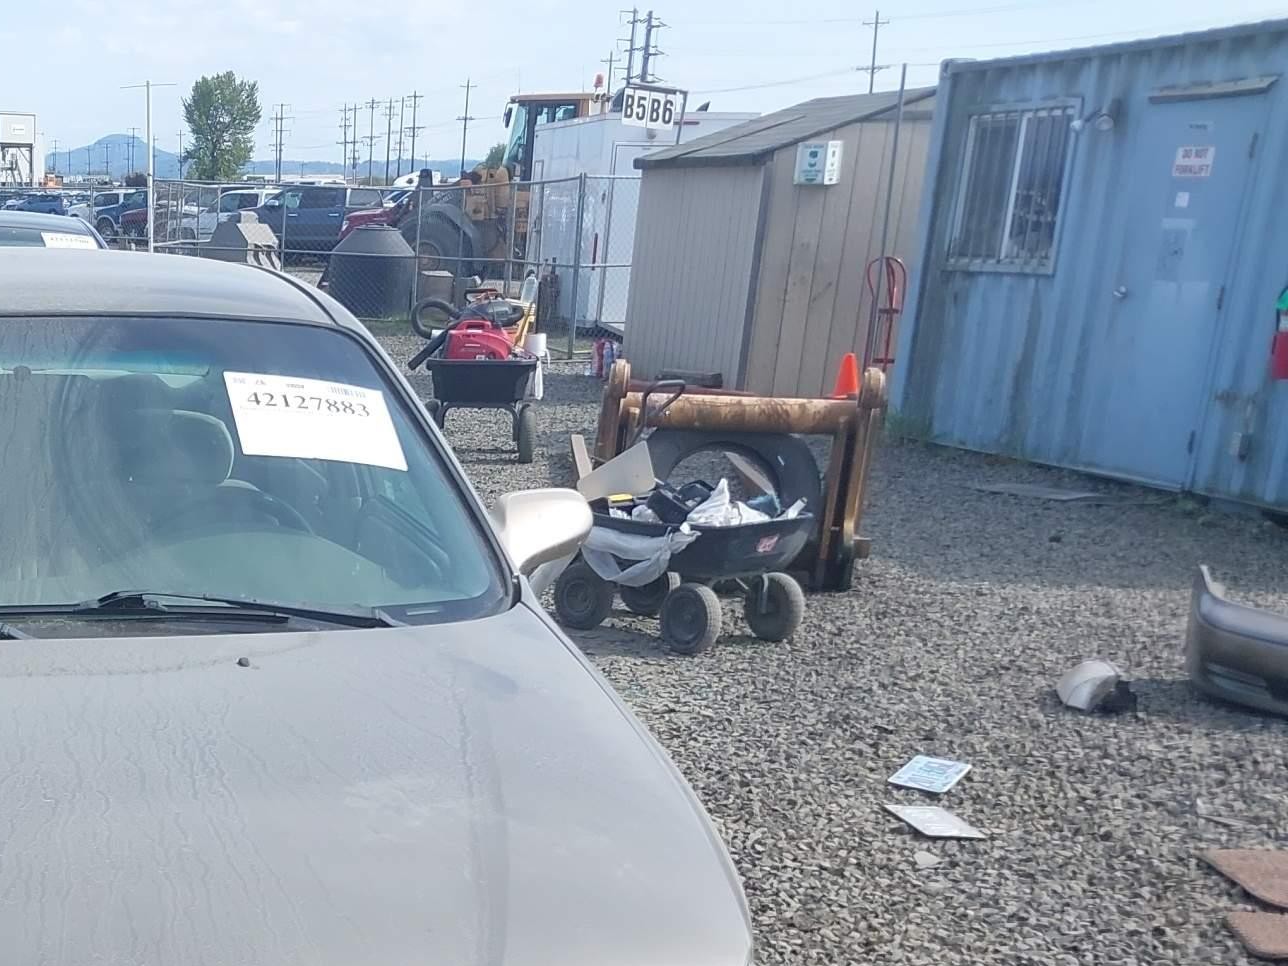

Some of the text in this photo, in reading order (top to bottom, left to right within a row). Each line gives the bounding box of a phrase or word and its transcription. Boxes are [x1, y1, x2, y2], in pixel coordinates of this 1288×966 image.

[1182, 147, 1209, 159] DO NOT
[1175, 163, 1210, 175] FORKLIFT
[246, 390, 371, 418] 42127883
